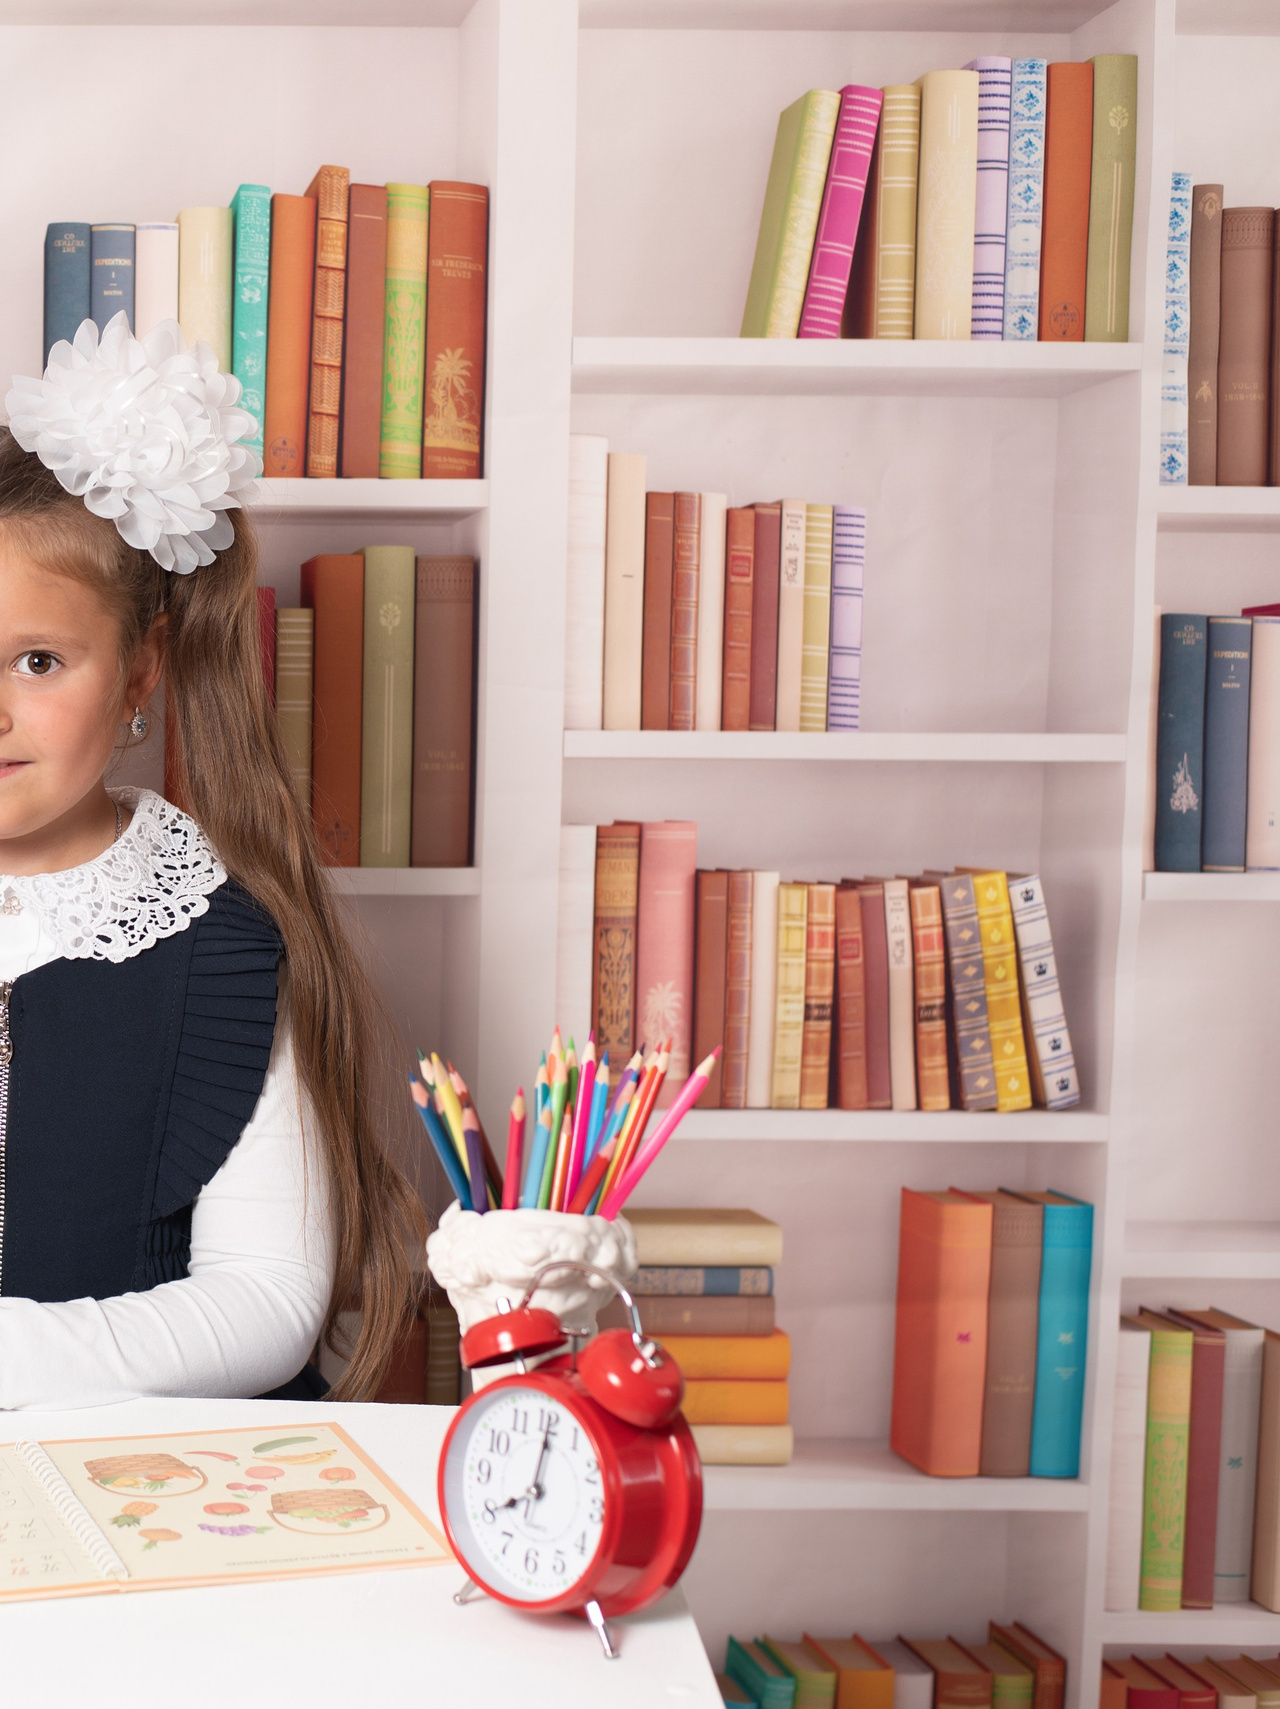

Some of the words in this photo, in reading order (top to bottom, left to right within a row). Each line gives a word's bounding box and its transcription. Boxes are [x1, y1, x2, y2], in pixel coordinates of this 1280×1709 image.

[431, 258, 443, 268] SIR
[445, 259, 485, 272] FREDERICK
[442, 269, 472, 279] TREVES
[512, 1408, 529, 1435] 11
[538, 1409, 561, 1437] 12
[489, 1429, 511, 1457] 10
[572, 1428, 579, 1451] 1
[477, 1459, 492, 1485] 9
[586, 1458, 599, 1486] 2
[482, 1499, 497, 1525] 8
[590, 1497, 605, 1524] 3
[502, 1531, 514, 1555] 7
[574, 1531, 587, 1556] 4
[525, 1548, 540, 1574] 6
[553, 1549, 566, 1575] 5
